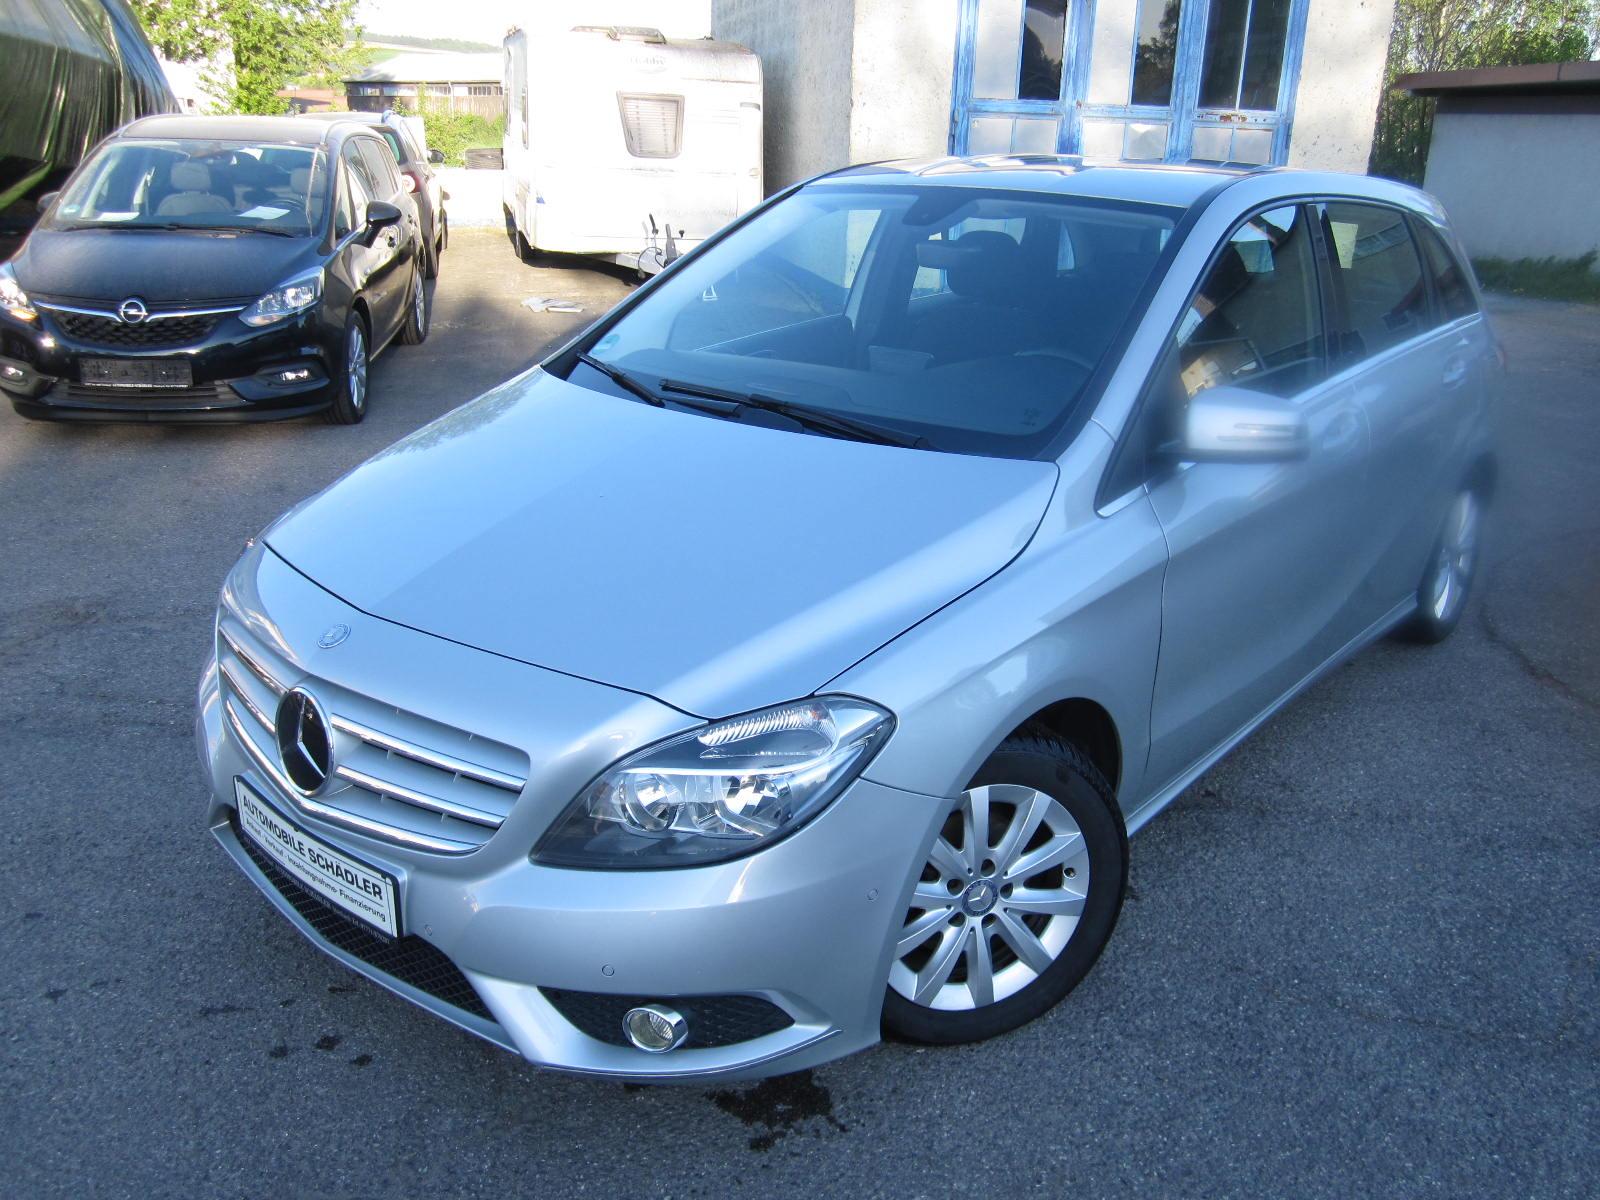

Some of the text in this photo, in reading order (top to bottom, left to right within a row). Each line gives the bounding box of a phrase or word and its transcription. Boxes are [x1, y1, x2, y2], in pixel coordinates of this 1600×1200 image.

[243, 795, 306, 856] AUTOMOBILE
[307, 848, 383, 900] SCHÄDLER
[339, 889, 386, 922] Finanzierung
